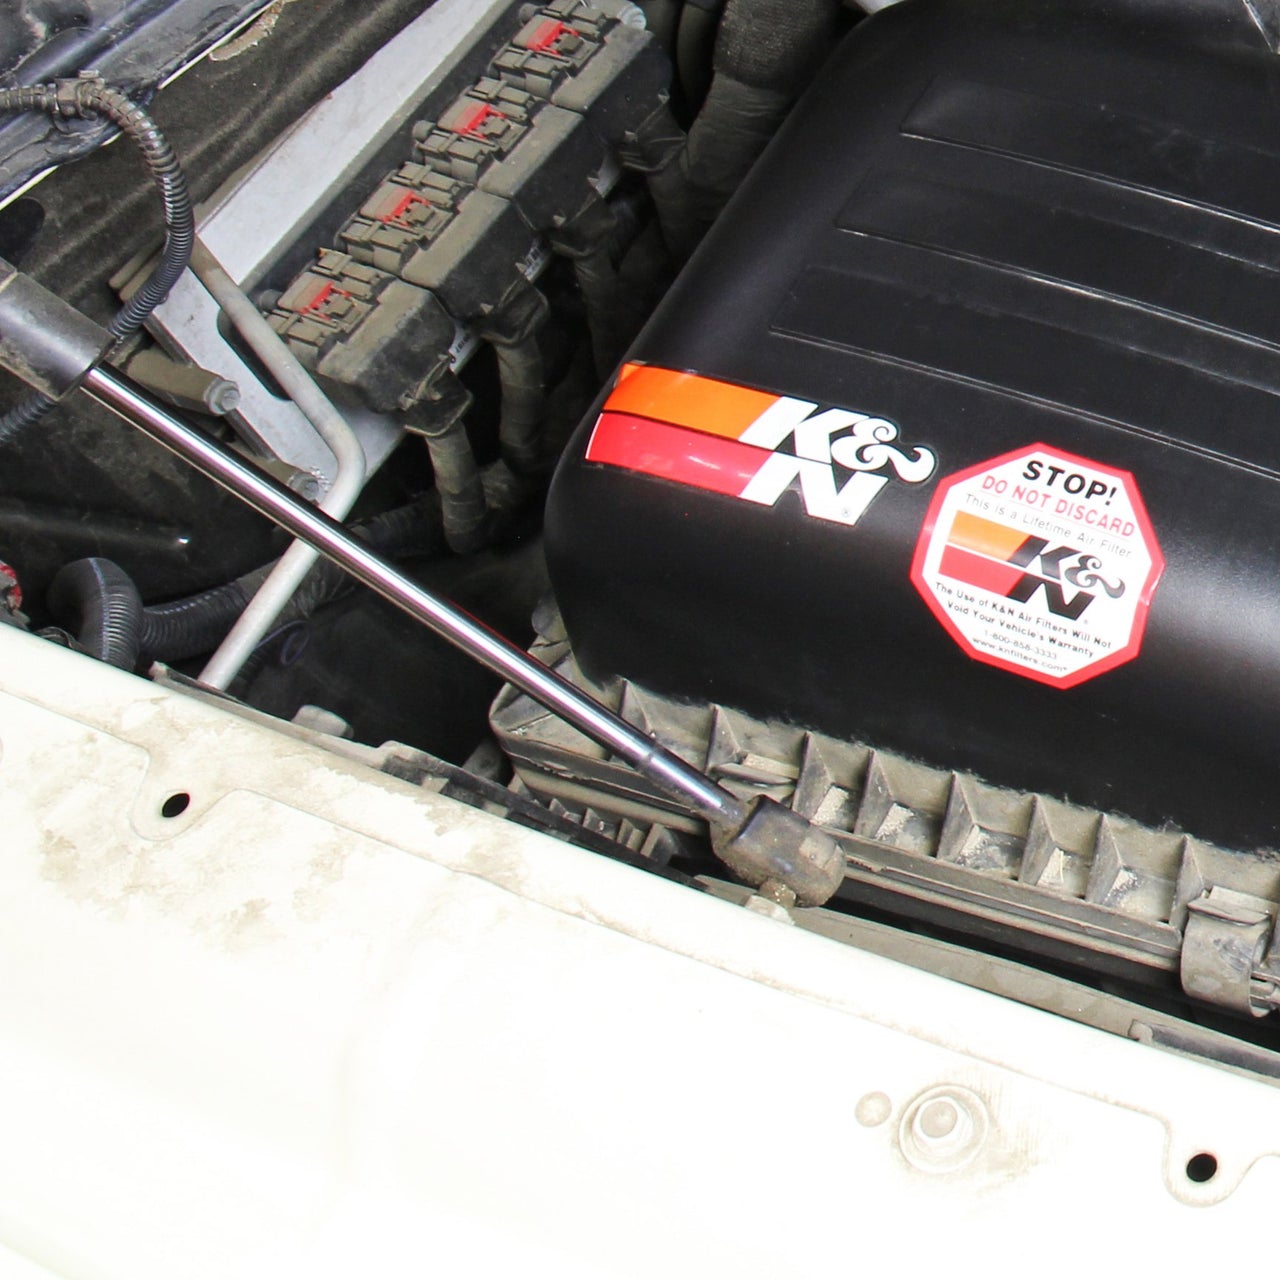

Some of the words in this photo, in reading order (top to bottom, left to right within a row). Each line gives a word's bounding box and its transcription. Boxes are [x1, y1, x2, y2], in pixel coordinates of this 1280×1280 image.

[982, 475, 1008, 494] DO
[1011, 485, 1052, 508] NOT
[1055, 499, 1135, 537] DISCARD
[1022, 460, 1118, 506] STOP!
[965, 493, 991, 510] This
[995, 504, 1005, 516] is
[1010, 511, 1017, 519] a
[1023, 513, 1072, 538] Lifetime
[1077, 532, 1095, 545] Air
[935, 582, 953, 596] The
[957, 590, 975, 604] Use
[978, 596, 988, 607] of
[991, 602, 1015, 617] K&N
[1018, 611, 1032, 623] Air
[1036, 617, 1068, 635] Filters
[1072, 630, 1090, 642] Will
[1094, 637, 1112, 649] Not
[947, 600, 969, 615] Void
[973, 610, 996, 624] Your
[999, 620, 1044, 641] Vehicle's
[1048, 636, 1094, 658] Warranty
[984, 629, 1057, 660] 1-800-858-3333
